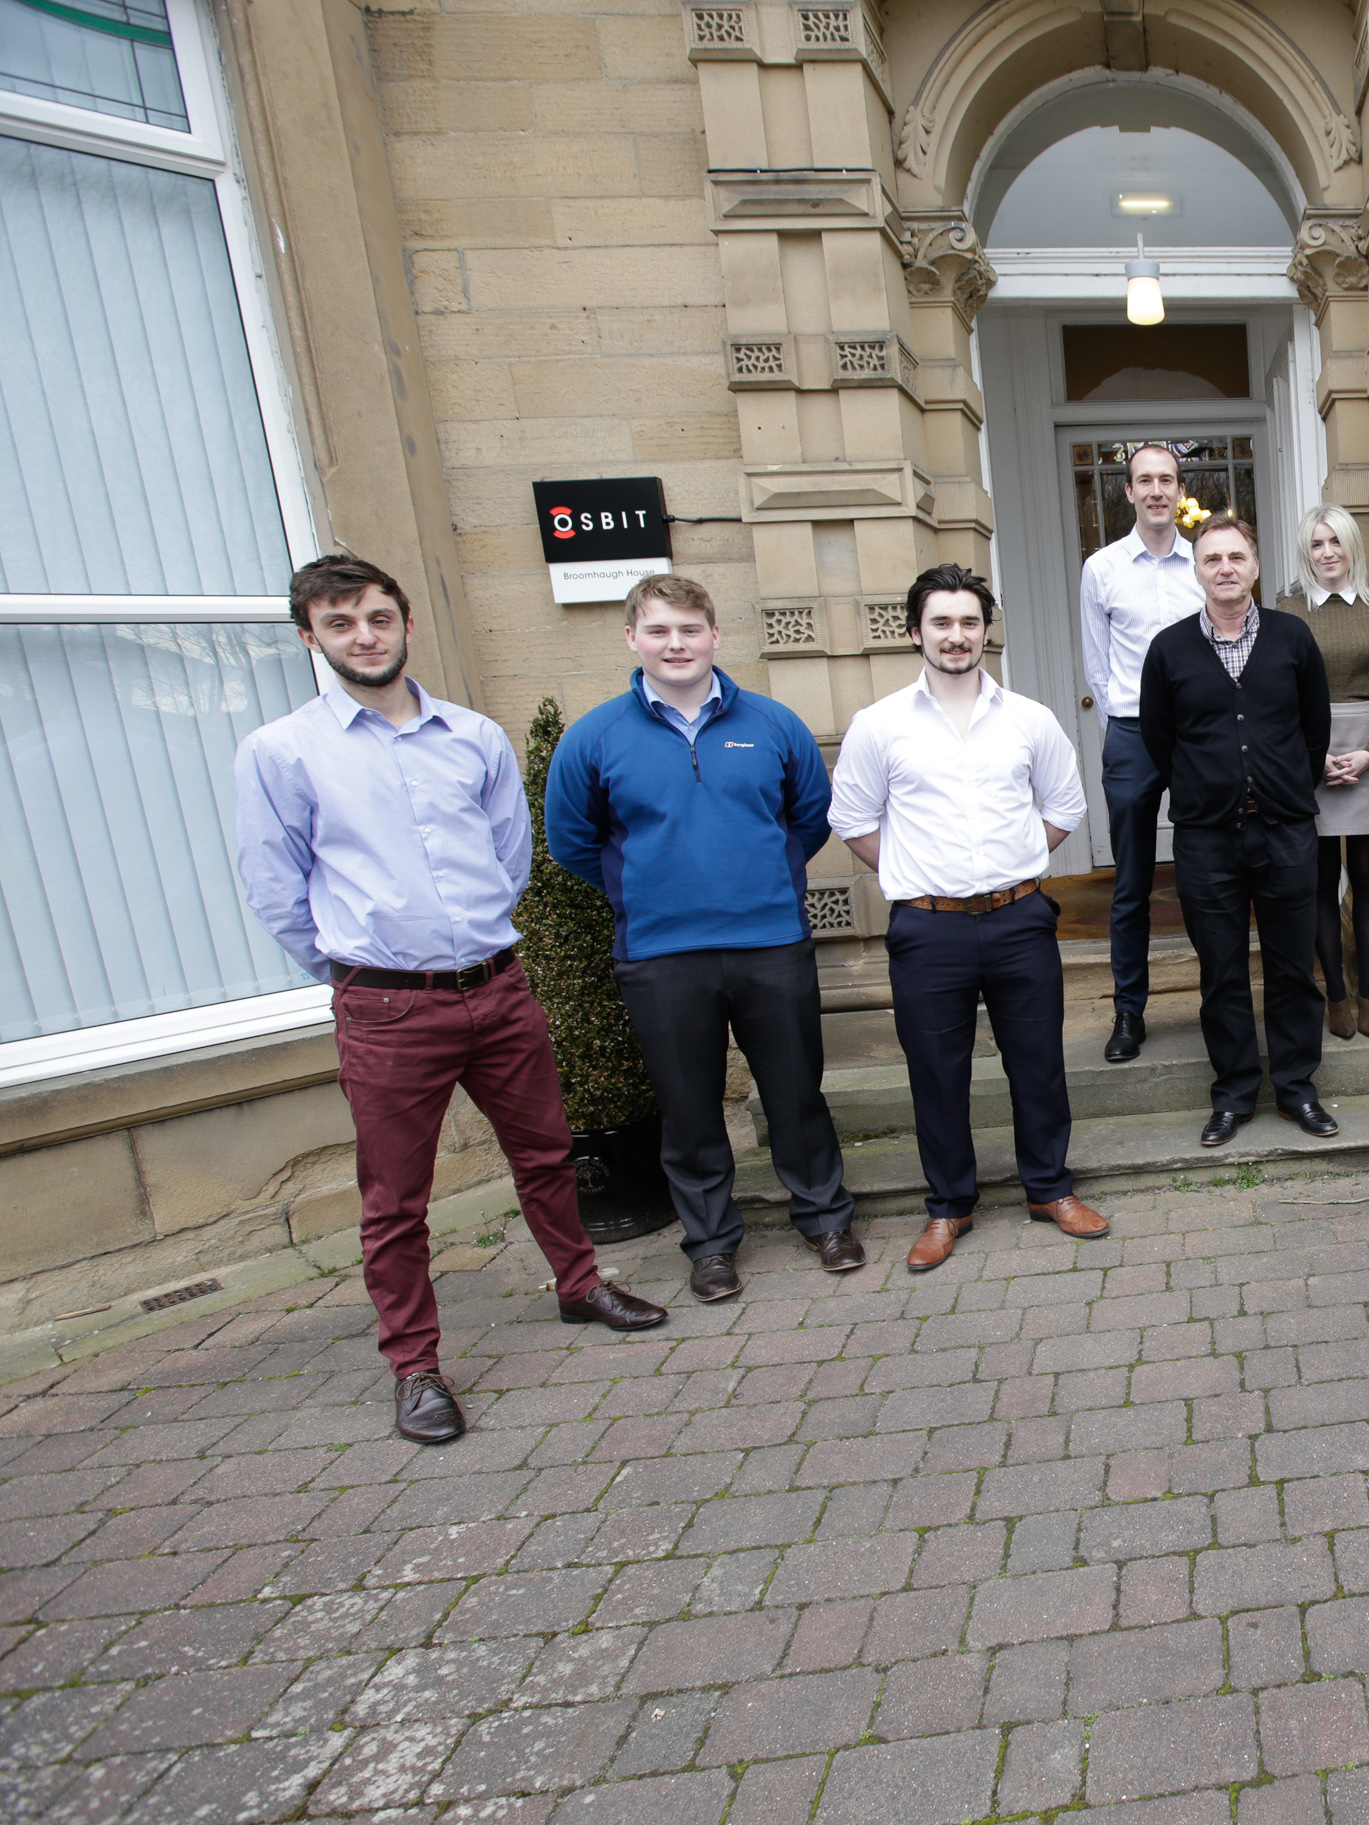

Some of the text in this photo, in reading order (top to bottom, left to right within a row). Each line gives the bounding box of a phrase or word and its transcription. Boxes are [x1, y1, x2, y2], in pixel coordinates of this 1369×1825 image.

[553, 510, 647, 533] OSBIT
[563, 569, 656, 580] Broomhaugh House
